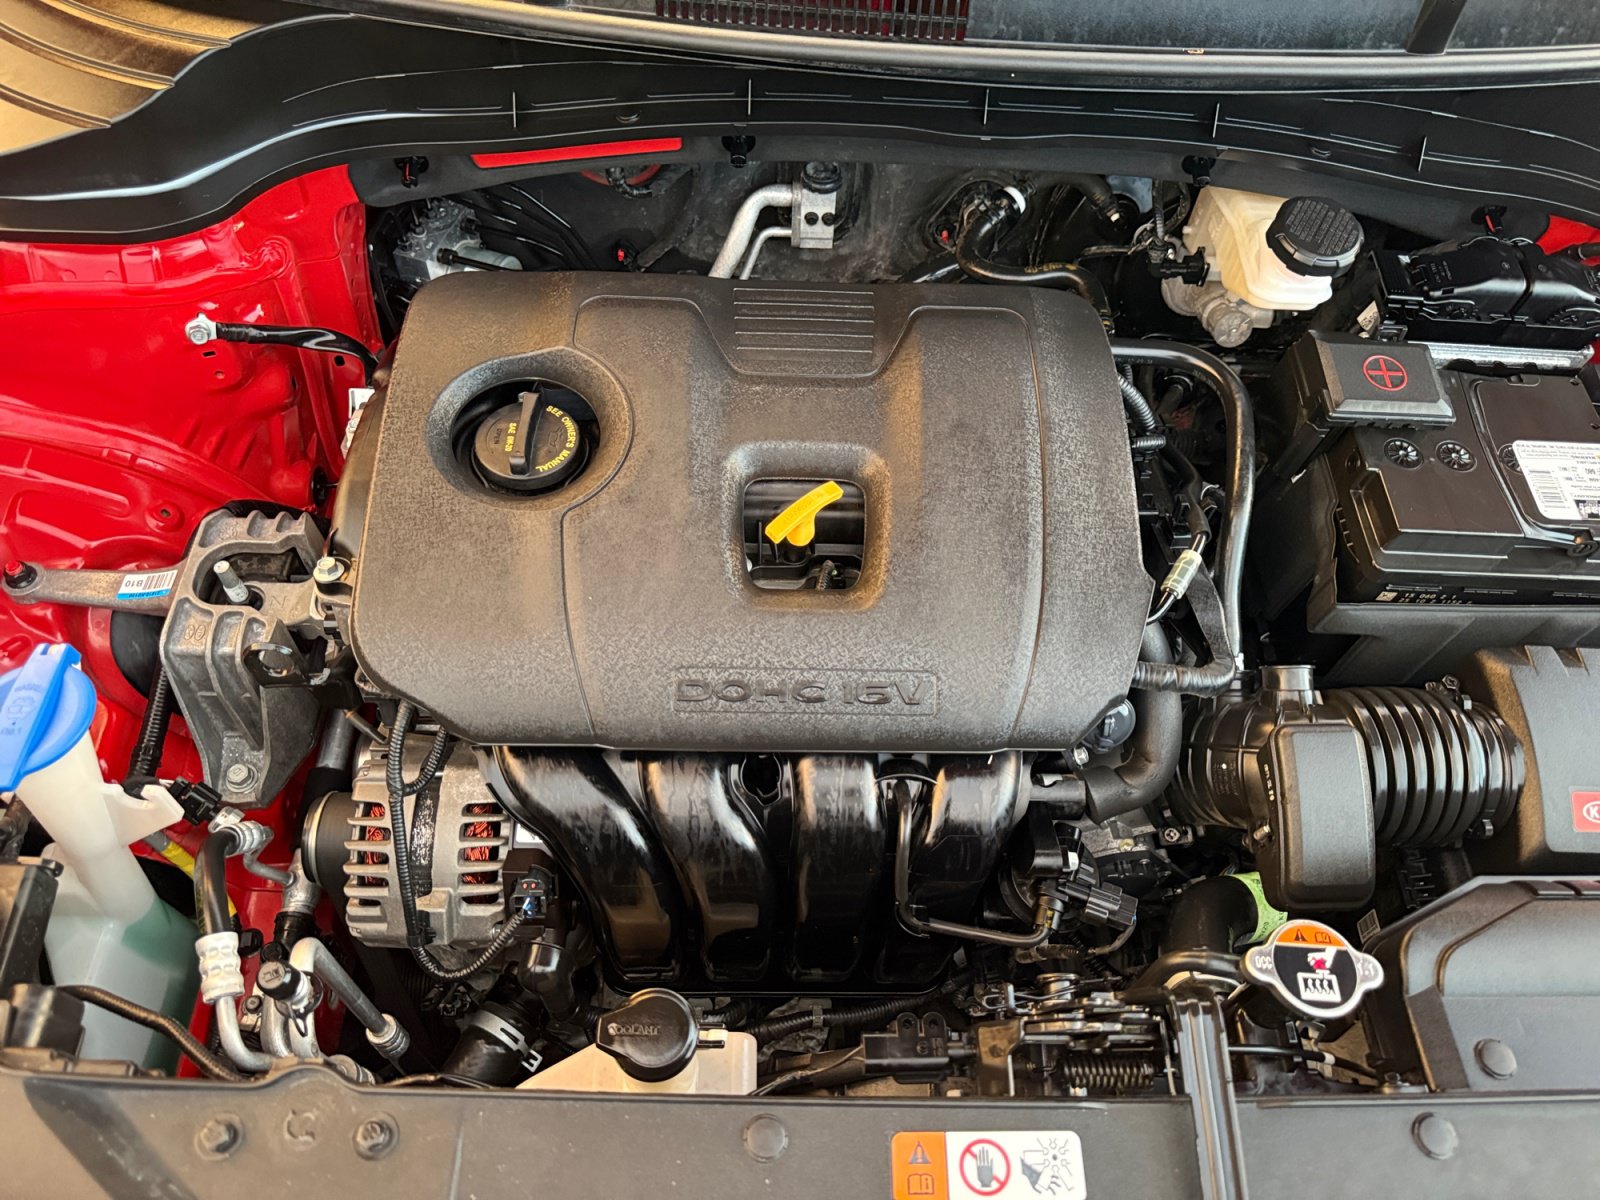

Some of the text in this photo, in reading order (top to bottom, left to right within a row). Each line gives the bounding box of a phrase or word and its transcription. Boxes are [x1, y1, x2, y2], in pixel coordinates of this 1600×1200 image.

[546, 405, 563, 418] SEE
[535, 449, 571, 473] MANUAL
[125, 579, 144, 588] B10
[676, 679, 931, 706] DOHC 16V
